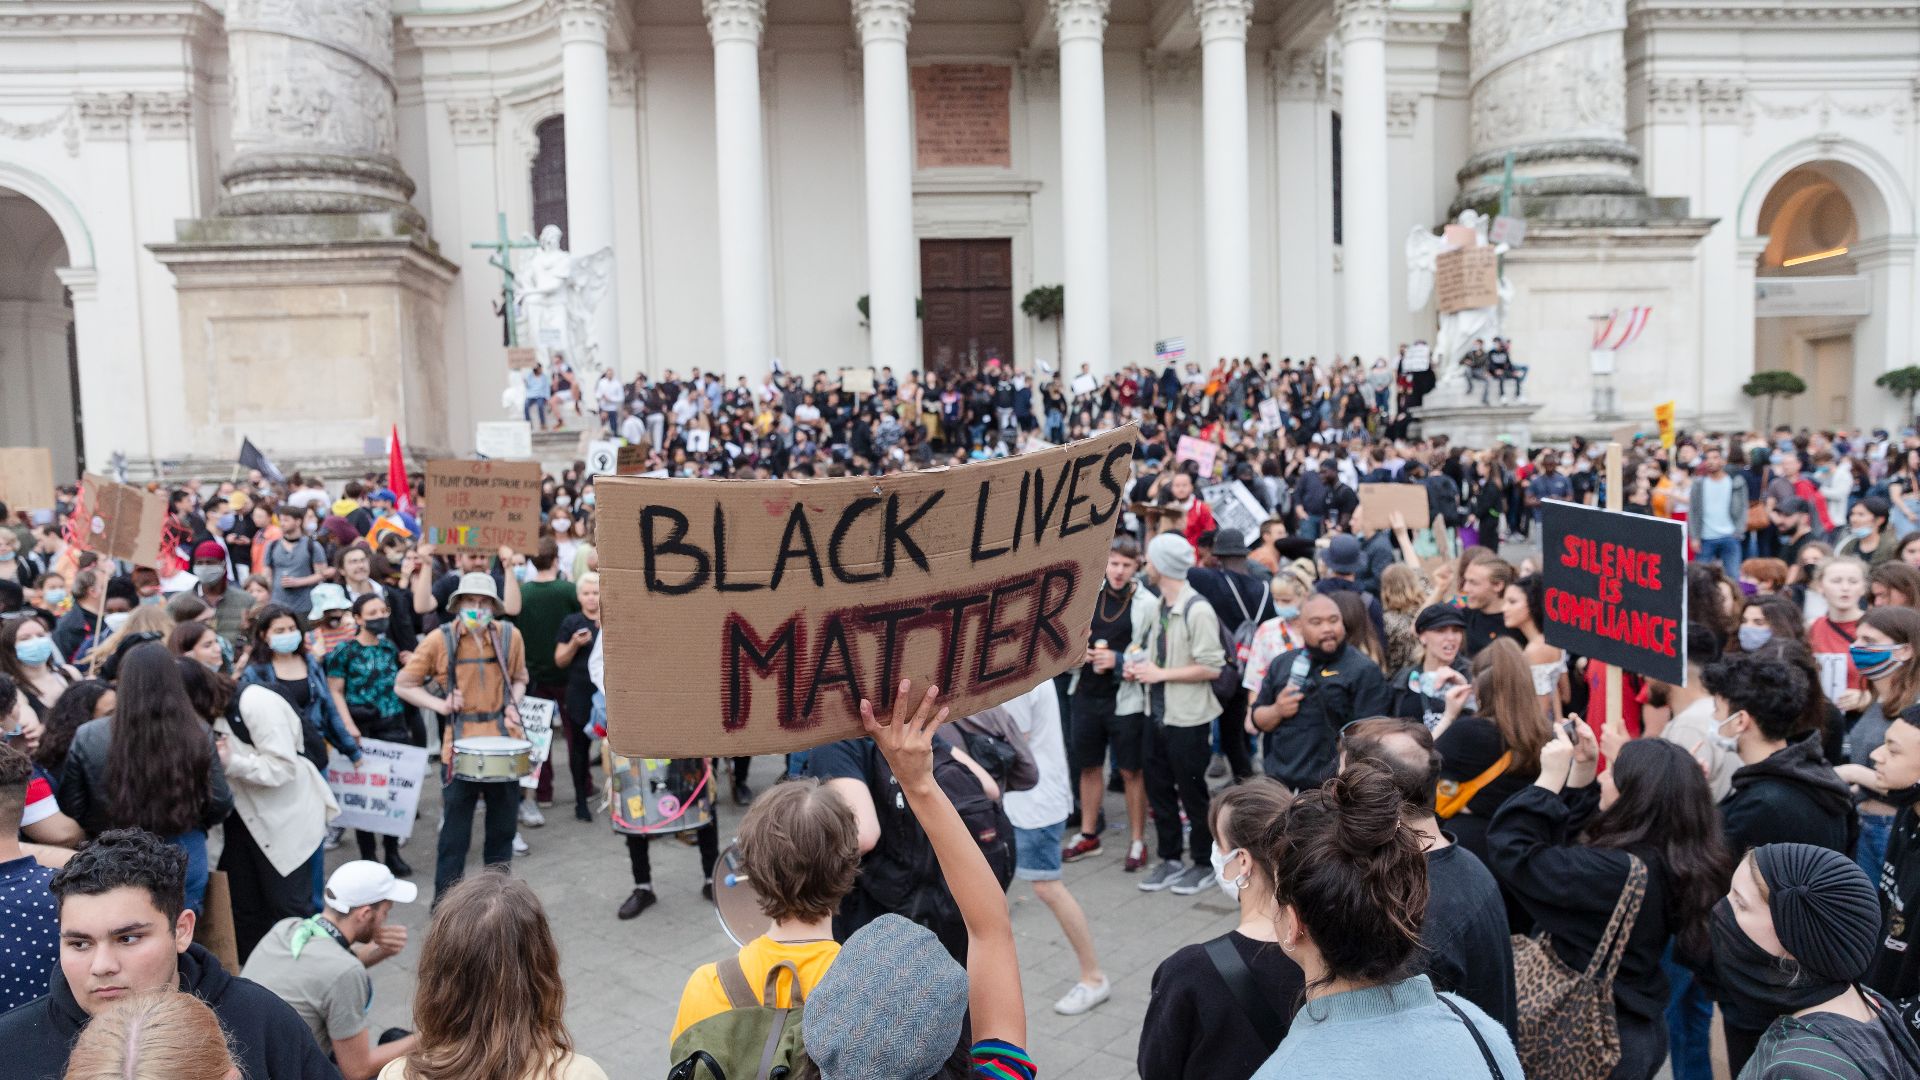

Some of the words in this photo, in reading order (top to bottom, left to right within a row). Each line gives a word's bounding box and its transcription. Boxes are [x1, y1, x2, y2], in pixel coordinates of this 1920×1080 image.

[640, 488, 945, 596] BLACK
[970, 443, 1133, 562] LIVES
[1561, 534, 1662, 590] SILENCE
[1599, 576, 1624, 604] IS
[721, 560, 1081, 733] MATTER
[1545, 587, 1677, 657] COMPLIANCE
